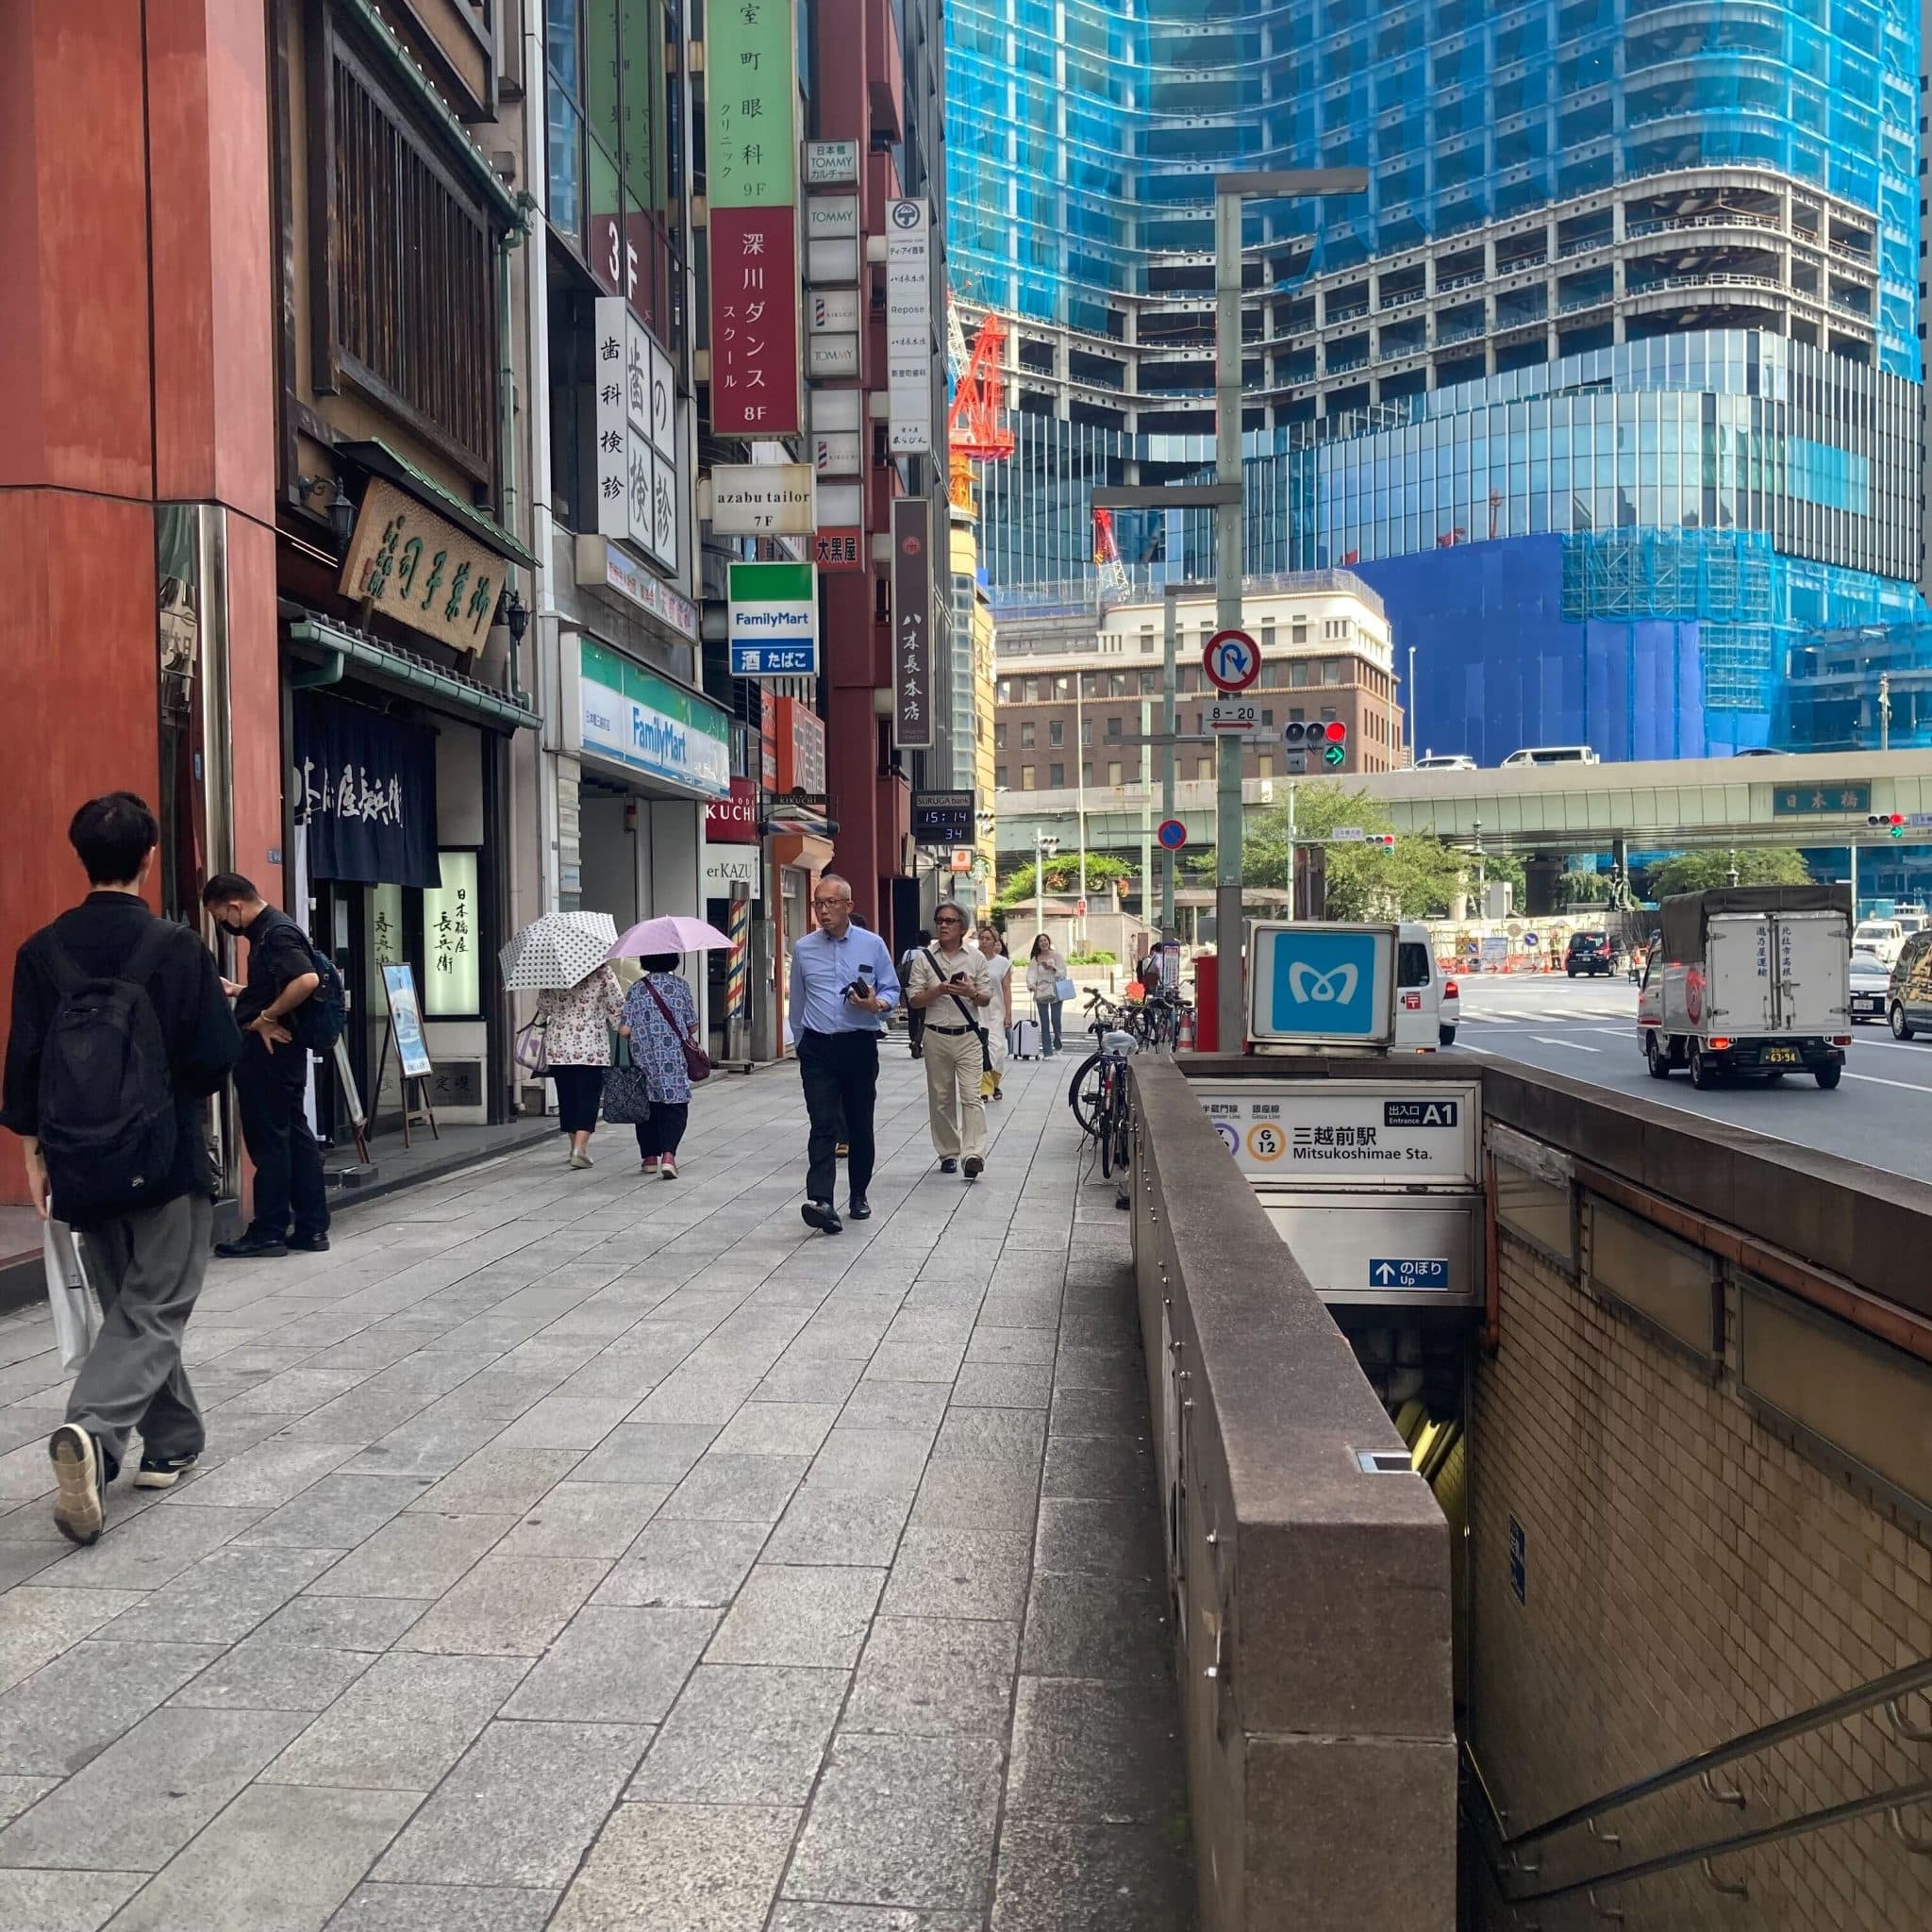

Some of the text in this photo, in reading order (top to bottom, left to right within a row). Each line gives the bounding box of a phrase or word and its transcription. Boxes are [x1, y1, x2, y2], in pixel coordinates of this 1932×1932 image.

[741, 3, 766, 196] 室町眼科 9F
[720, 104, 732, 178] クリニック
[817, 145, 845, 156] 日本橋
[811, 157, 853, 168] TOMMY
[811, 170, 853, 179] カルチャー
[811, 211, 853, 223] TOMMY
[891, 306, 925, 314] Repose
[742, 233, 767, 421] 深川ダンス 8F
[724, 306, 736, 389] スクール
[815, 350, 853, 360] TOMMY
[600, 337, 625, 500] 歯科検診
[717, 490, 810, 504] azabu tailor
[817, 538, 858, 563] 大黒屋
[736, 613, 808, 628] FamilyMart
[741, 650, 806, 671] 酒 たばこ
[633, 707, 687, 765] FamilyMart
[917, 794, 969, 805] SURUGA bank
[1786, 791, 1859, 808] 日本橋
[945, 828, 962, 840] 34
[433, 911, 453, 974] 長兵衛
[1253, 1105, 1279, 1113] 銀座線
[1389, 1106, 1419, 1116] 出入口
[1422, 1104, 1453, 1124] A1
[1260, 1129, 1272, 1141] G
[1293, 1127, 1376, 1145] 三越前駅
[1258, 1142, 1275, 1153] 12
[1293, 1147, 1433, 1160] Mitsukoshimae Sta.
[1400, 1261, 1441, 1274] のぼり
[1400, 1276, 1414, 1287] Up
